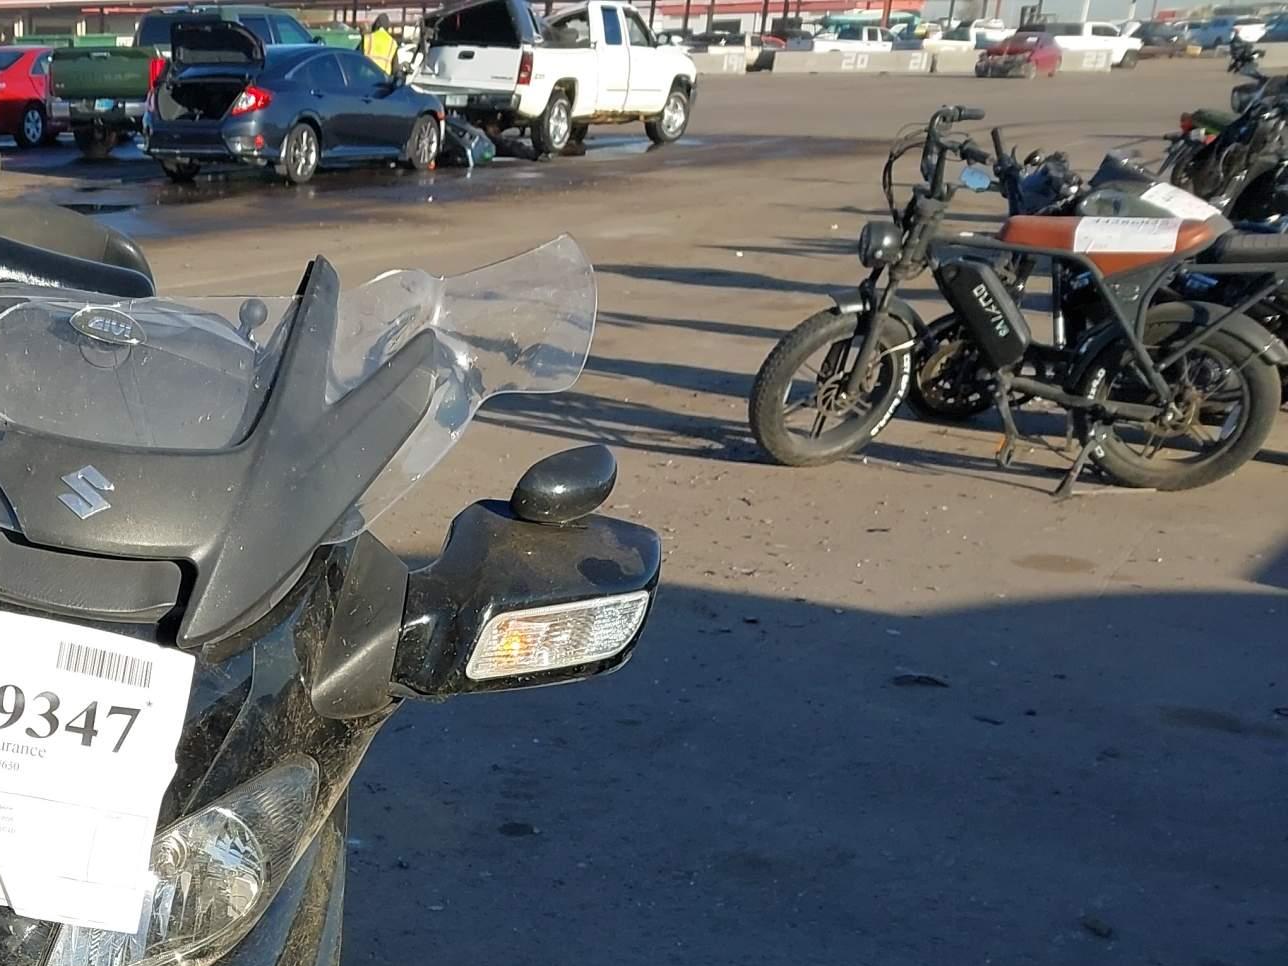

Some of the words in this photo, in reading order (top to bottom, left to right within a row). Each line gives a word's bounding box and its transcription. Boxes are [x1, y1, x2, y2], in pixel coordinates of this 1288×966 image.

[841, 51, 869, 70] 20
[909, 51, 929, 70] 21
[1081, 51, 1106, 68] 23
